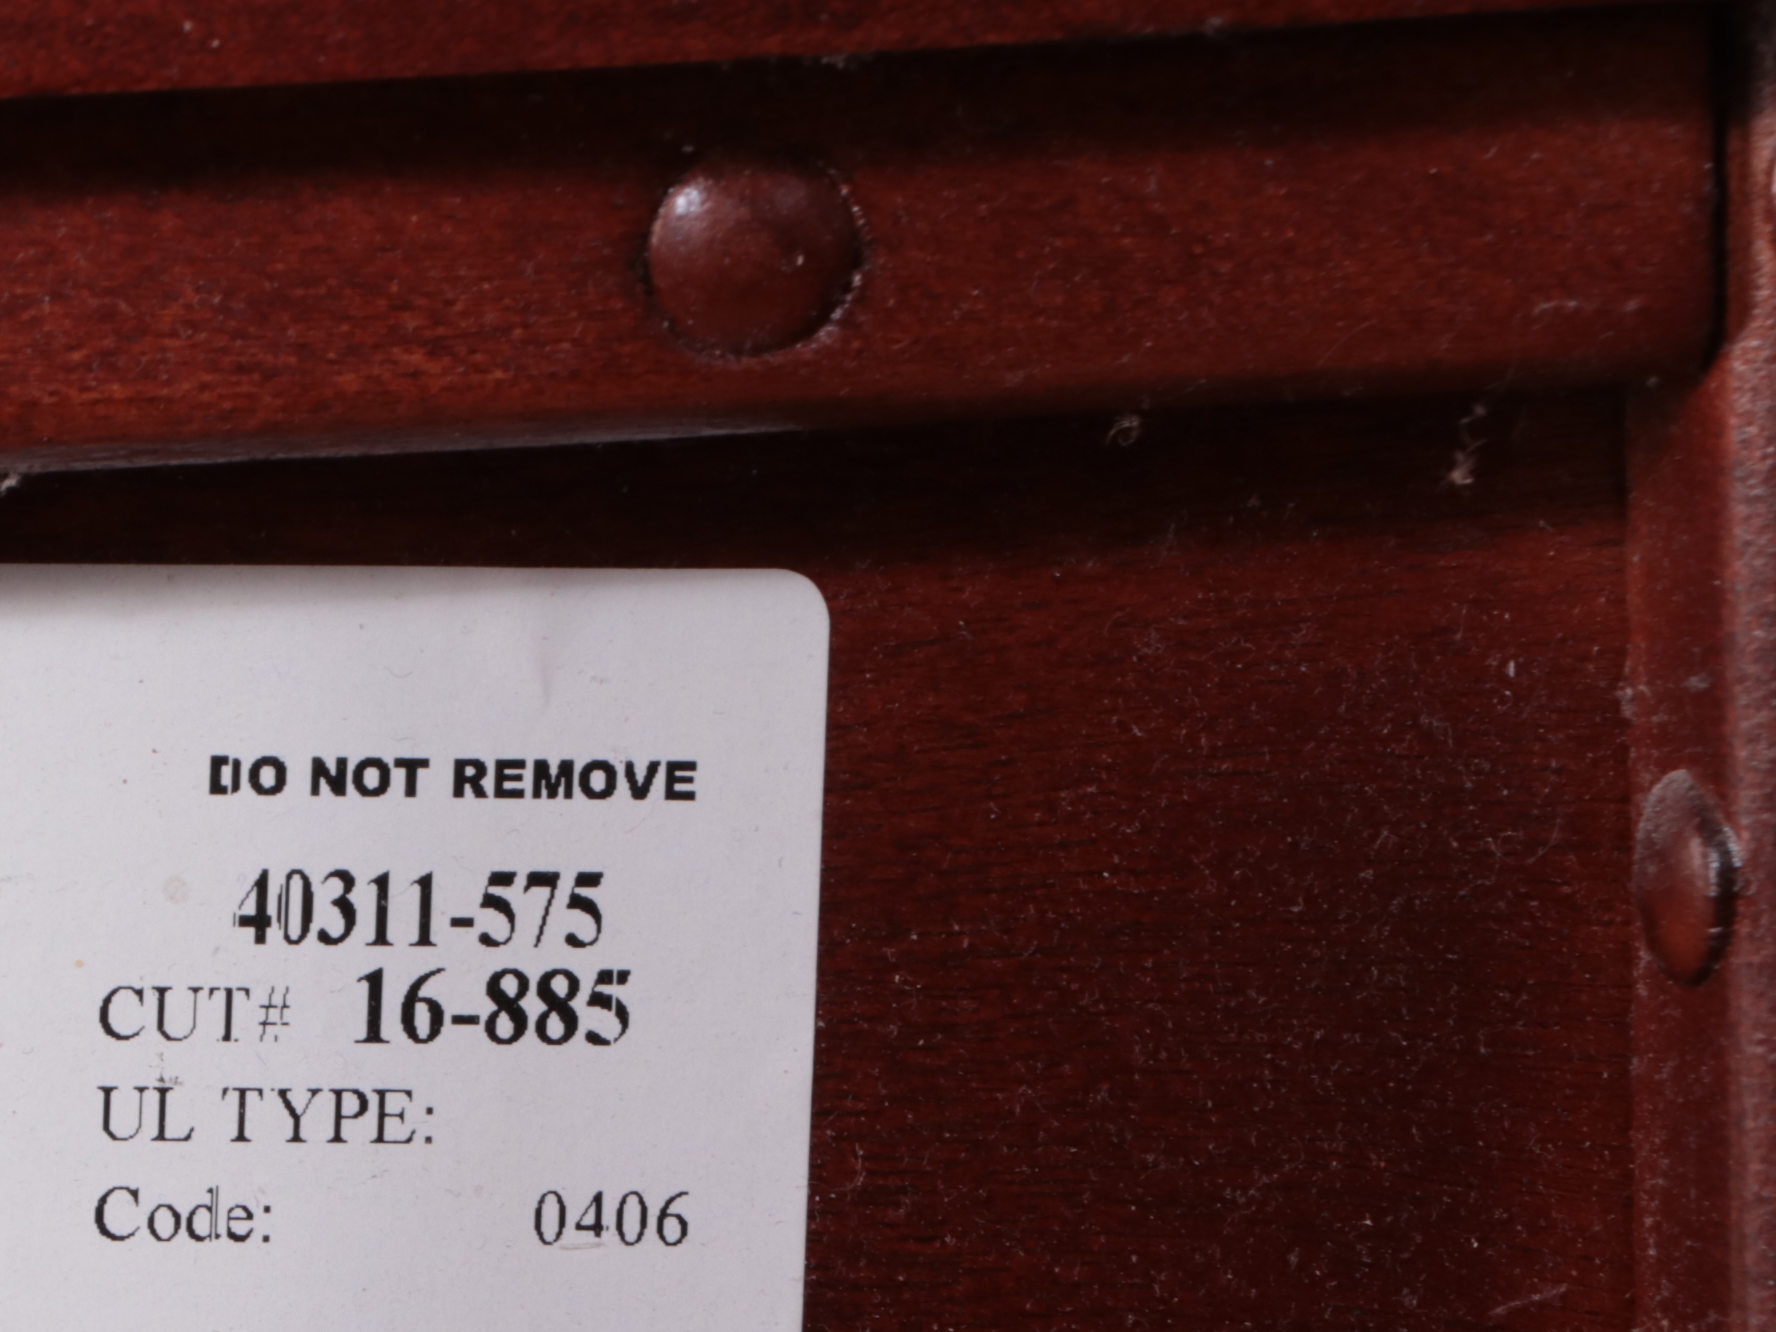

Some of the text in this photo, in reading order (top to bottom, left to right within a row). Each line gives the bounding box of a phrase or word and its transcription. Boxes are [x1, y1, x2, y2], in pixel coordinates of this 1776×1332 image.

[208, 754, 698, 802] DO NOT REMOVE
[233, 868, 604, 948] 40311-575
[98, 967, 632, 1047] CUT# 16-885
[97, 1086, 435, 1145] UL TYPE:
[93, 1186, 689, 1247] Code: 0406
